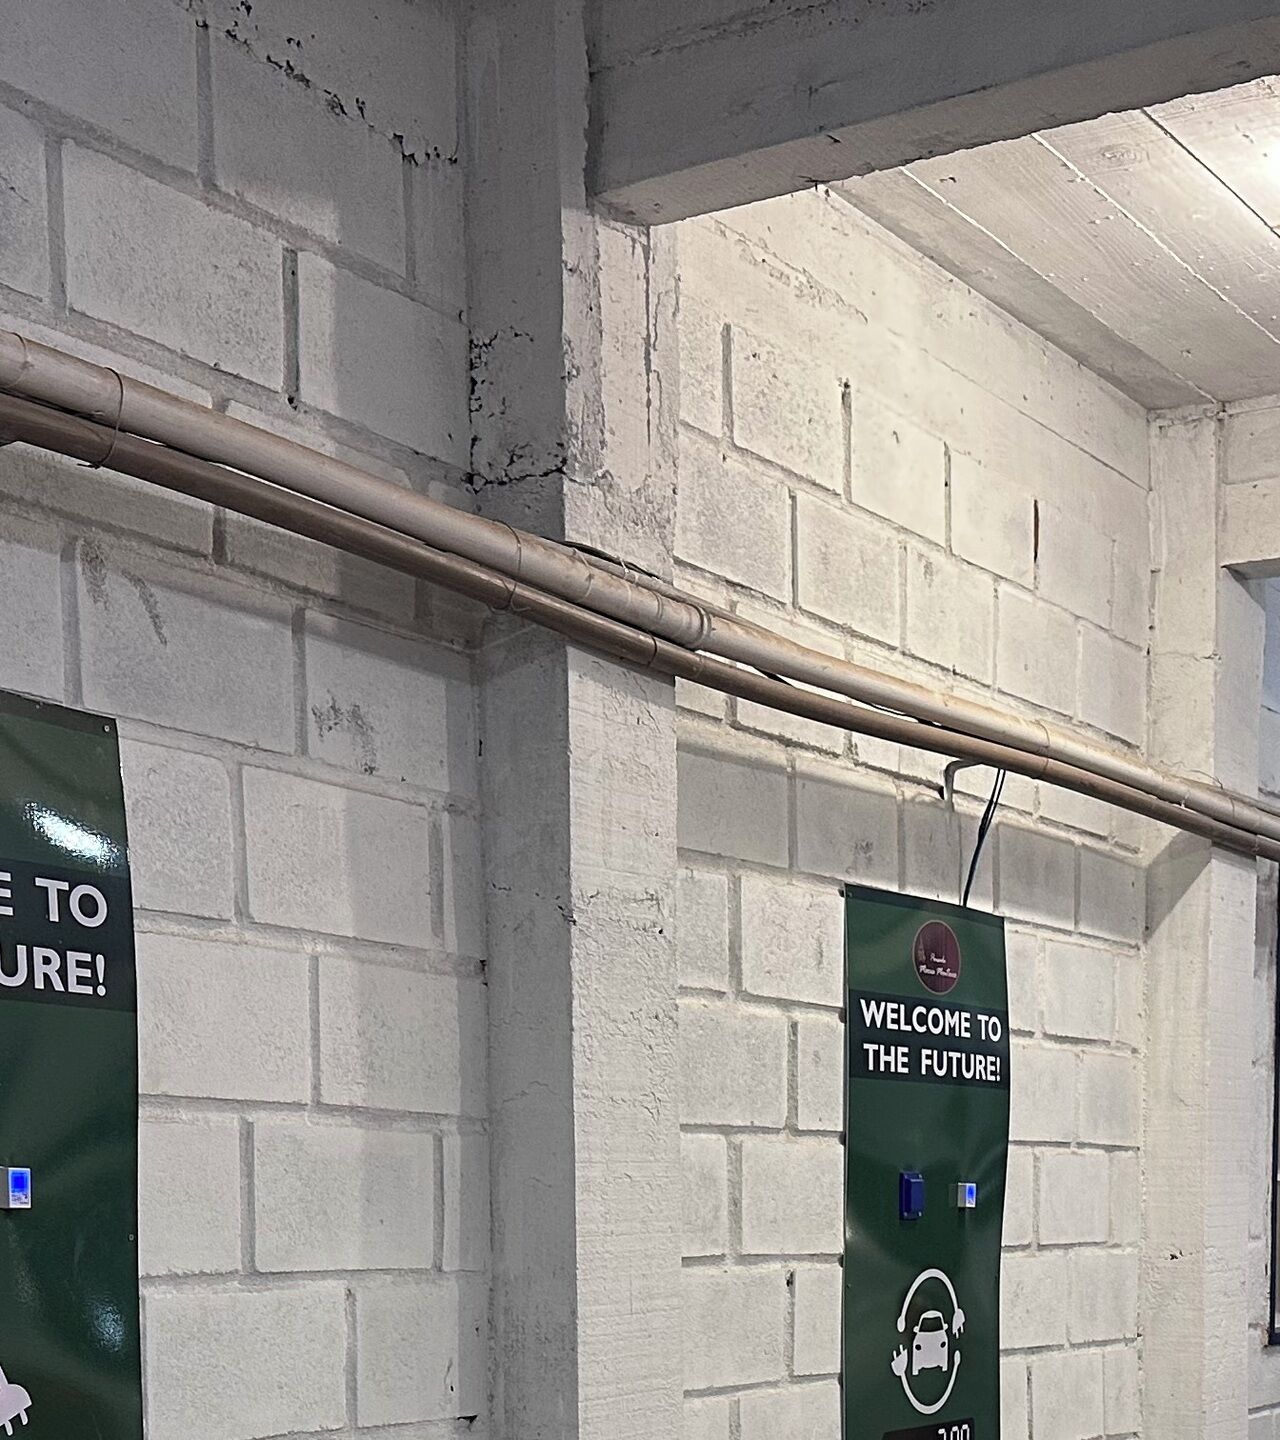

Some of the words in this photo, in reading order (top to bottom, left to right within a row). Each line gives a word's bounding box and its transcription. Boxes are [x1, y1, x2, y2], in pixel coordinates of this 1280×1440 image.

[34, 876, 108, 928] TO
[859, 998, 971, 1038] WELCOME
[977, 1013, 1002, 1043] TO
[863, 1043, 910, 1074] THE
[921, 1048, 1001, 1082] FUTURE!
